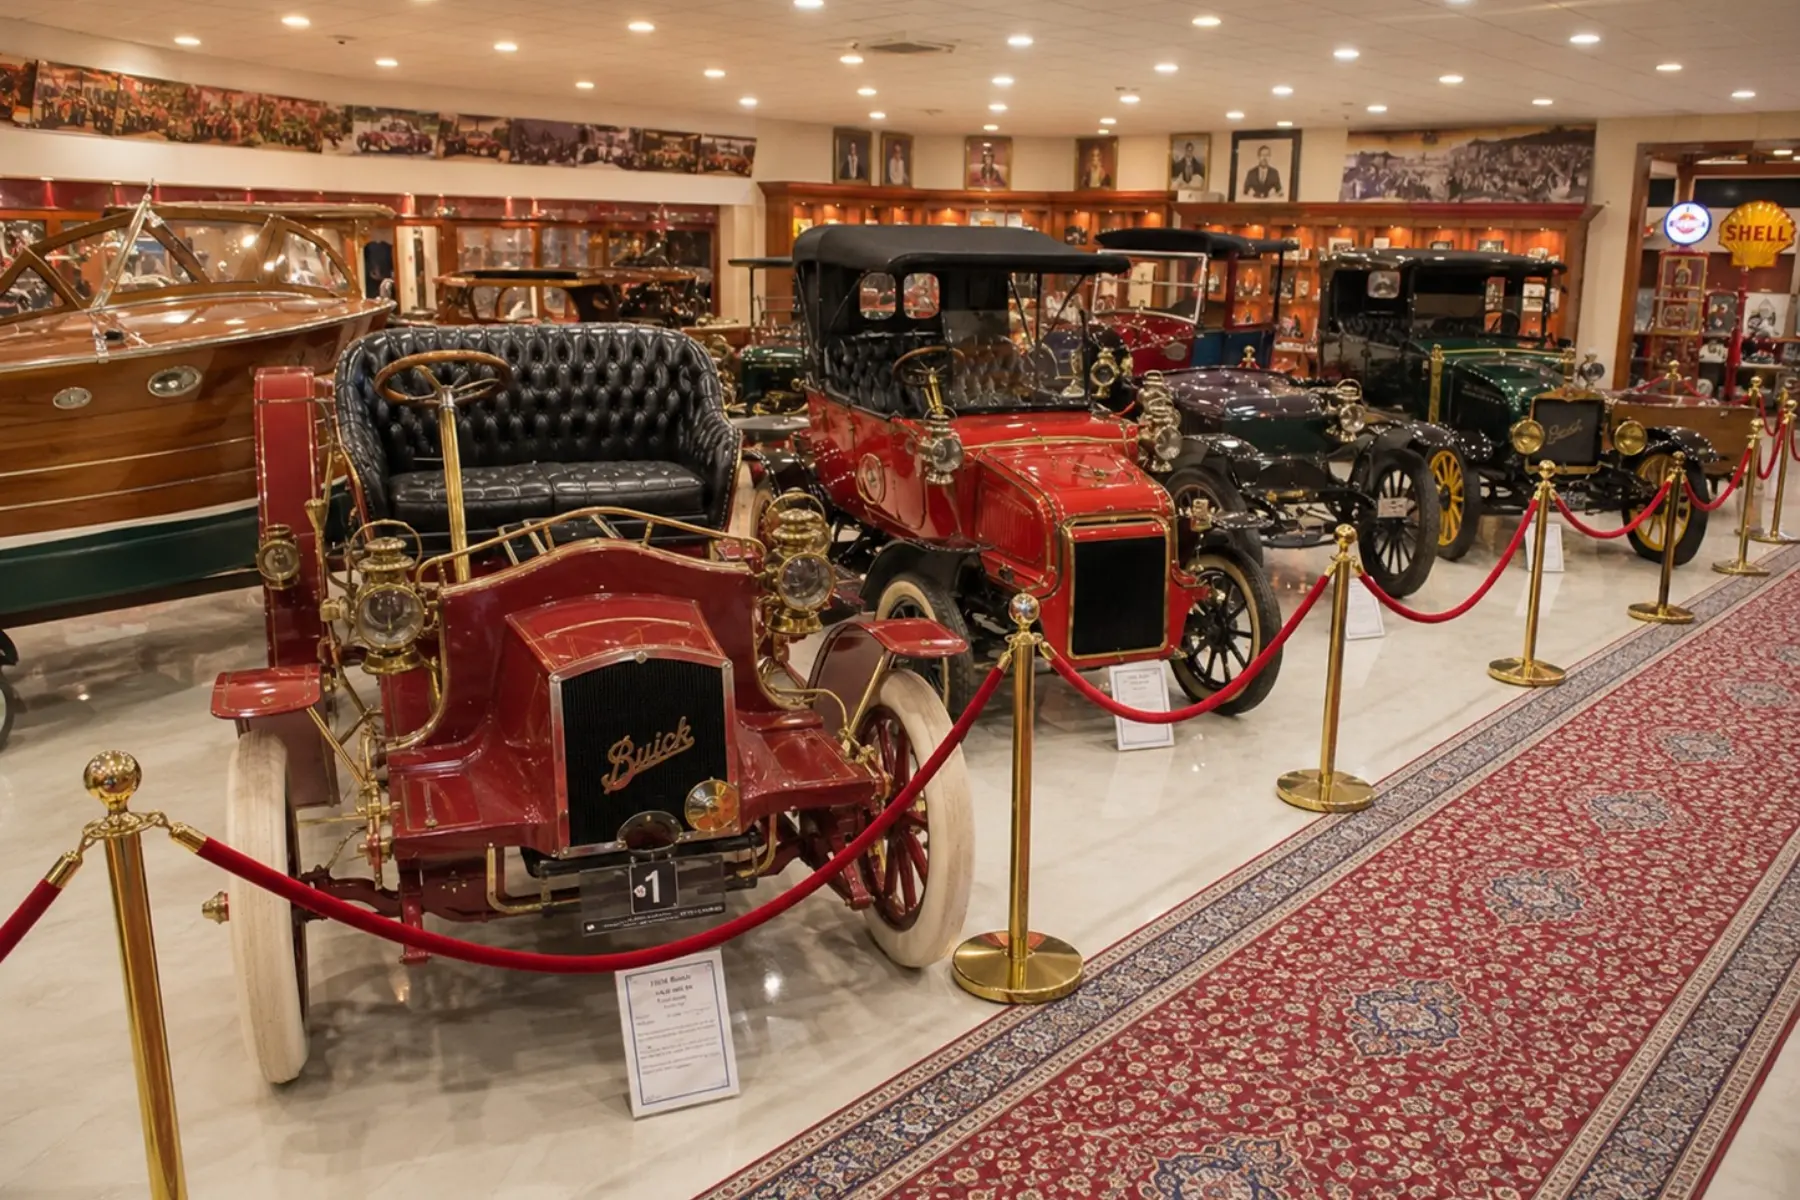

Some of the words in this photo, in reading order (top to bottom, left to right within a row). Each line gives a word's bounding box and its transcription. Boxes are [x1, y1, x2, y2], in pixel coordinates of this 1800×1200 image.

[1726, 225, 1788, 242] SHELL
[602, 716, 694, 794] Buick
[644, 869, 661, 904] 1
